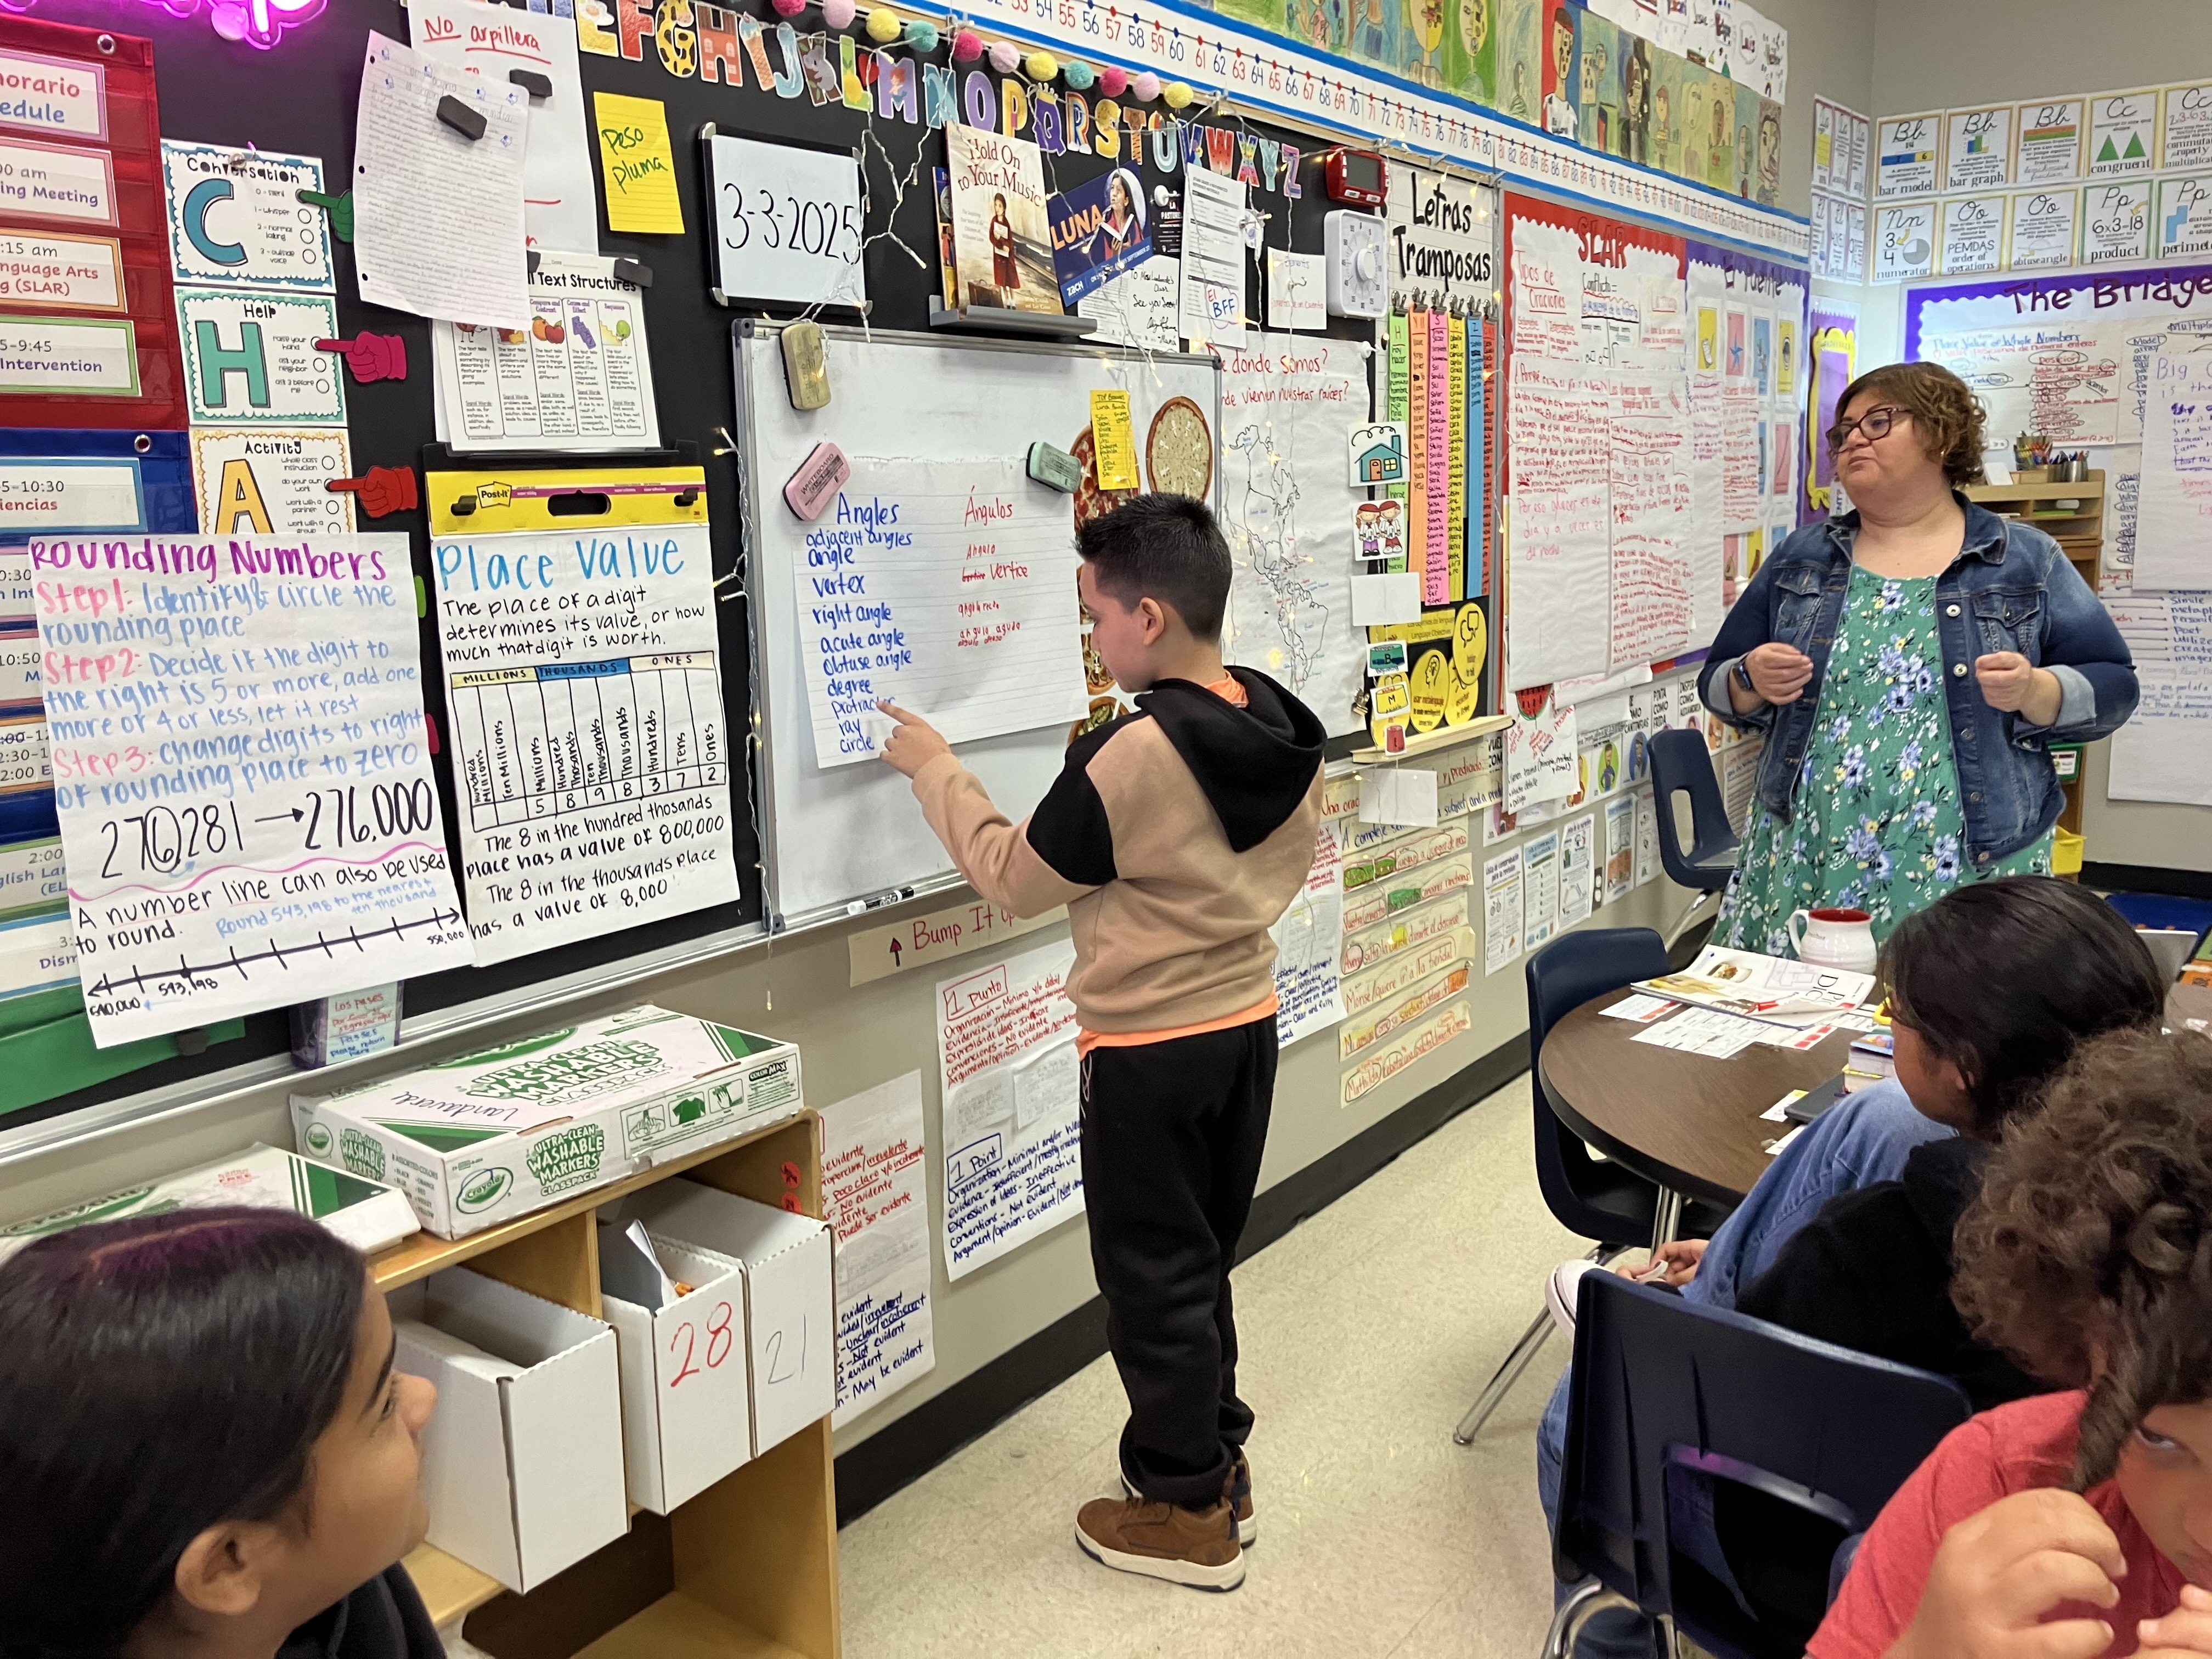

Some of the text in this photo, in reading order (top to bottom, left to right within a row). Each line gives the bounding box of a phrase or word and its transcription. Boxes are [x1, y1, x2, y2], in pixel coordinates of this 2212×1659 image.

[424, 15, 541, 52] No arpillera
[1059, 5, 1298, 95] 55 56 57 58 60 62 64 66
[601, 127, 645, 156] Peso
[968, 139, 1020, 170] Hold On
[187, 158, 299, 183] Conversation
[612, 156, 668, 194] pluma
[2091, 159, 2151, 174] congruent
[958, 165, 1041, 207] to Your Music
[1880, 180, 1932, 196] bar model
[1950, 173, 2004, 189] bar graph
[33, 185, 98, 207] Meeting
[1412, 171, 1472, 234] Letras
[183, 178, 248, 267] C
[724, 182, 860, 266] 3-3-2025
[1051, 204, 1103, 251] LUNA
[1577, 217, 1627, 270] SLAR
[1948, 240, 1995, 254] PEMDAS
[1978, 252, 1986, 261] of
[2091, 245, 2140, 263] product
[1392, 225, 1491, 292] Tramposas
[1514, 249, 1555, 289] Tipos de
[1948, 262, 1995, 274] operations
[66, 266, 98, 279] Arts
[538, 272, 637, 292] Text Structures
[1877, 268, 1930, 279] numerator
[16, 279, 70, 296] (SLAR)
[1529, 290, 1566, 310] Oraciones
[2004, 280, 2073, 315] The
[244, 304, 276, 318] Help
[1212, 298, 1236, 319] BFF
[1, 358, 102, 372] Intervention
[1233, 348, 1328, 375] donde somos?
[2157, 357, 2187, 380] Big
[1242, 385, 1276, 403] vienen
[245, 441, 302, 454] Activity
[837, 492, 900, 532] Angles
[965, 486, 1013, 527] Ángulos
[806, 528, 912, 553] adjacent angles
[230, 540, 386, 580] Numbers
[436, 537, 685, 591] Place Value
[808, 547, 855, 572] angle
[447, 606, 705, 640] determines its value, or how
[812, 602, 893, 630] right angle
[43, 614, 244, 651] rounding place
[821, 629, 904, 654] acute angle
[150, 640, 388, 678] Decide if the digit to
[463, 656, 693, 684] MILLIONS THOUSANDS ONES
[877, 650, 912, 674] angle
[827, 679, 873, 698] degree
[1653, 687, 1667, 700] PINTA
[1680, 692, 1694, 705] COMO
[1653, 701, 1668, 714] COMO
[839, 719, 861, 737] ray
[675, 731, 686, 766] Tens
[706, 723, 717, 761] Ones
[840, 736, 875, 754] circle
[1321, 797, 1340, 816] Una
[1443, 799, 1465, 815] subject
[585, 810, 644, 833] hundred
[592, 859, 673, 884] thousands
[105, 879, 270, 926] number line
[912, 904, 994, 950] Bump It
[335, 1000, 351, 1012] Los
[968, 980, 1001, 1008] punto
[467, 1042, 659, 1098] WASHABLE
[534, 1124, 596, 1154] ULTRA-CLEAN
[527, 1136, 604, 1172] WASHABLE
[969, 1146, 997, 1172] Point
[1008, 1142, 1040, 1170] Minimal
[539, 1152, 600, 1186] MARKERS
[540, 1170, 597, 1197] CLASSPACK
[669, 1301, 734, 1390] 28
[765, 1312, 807, 1385] 21
[853, 1339, 923, 1400] May be evident
